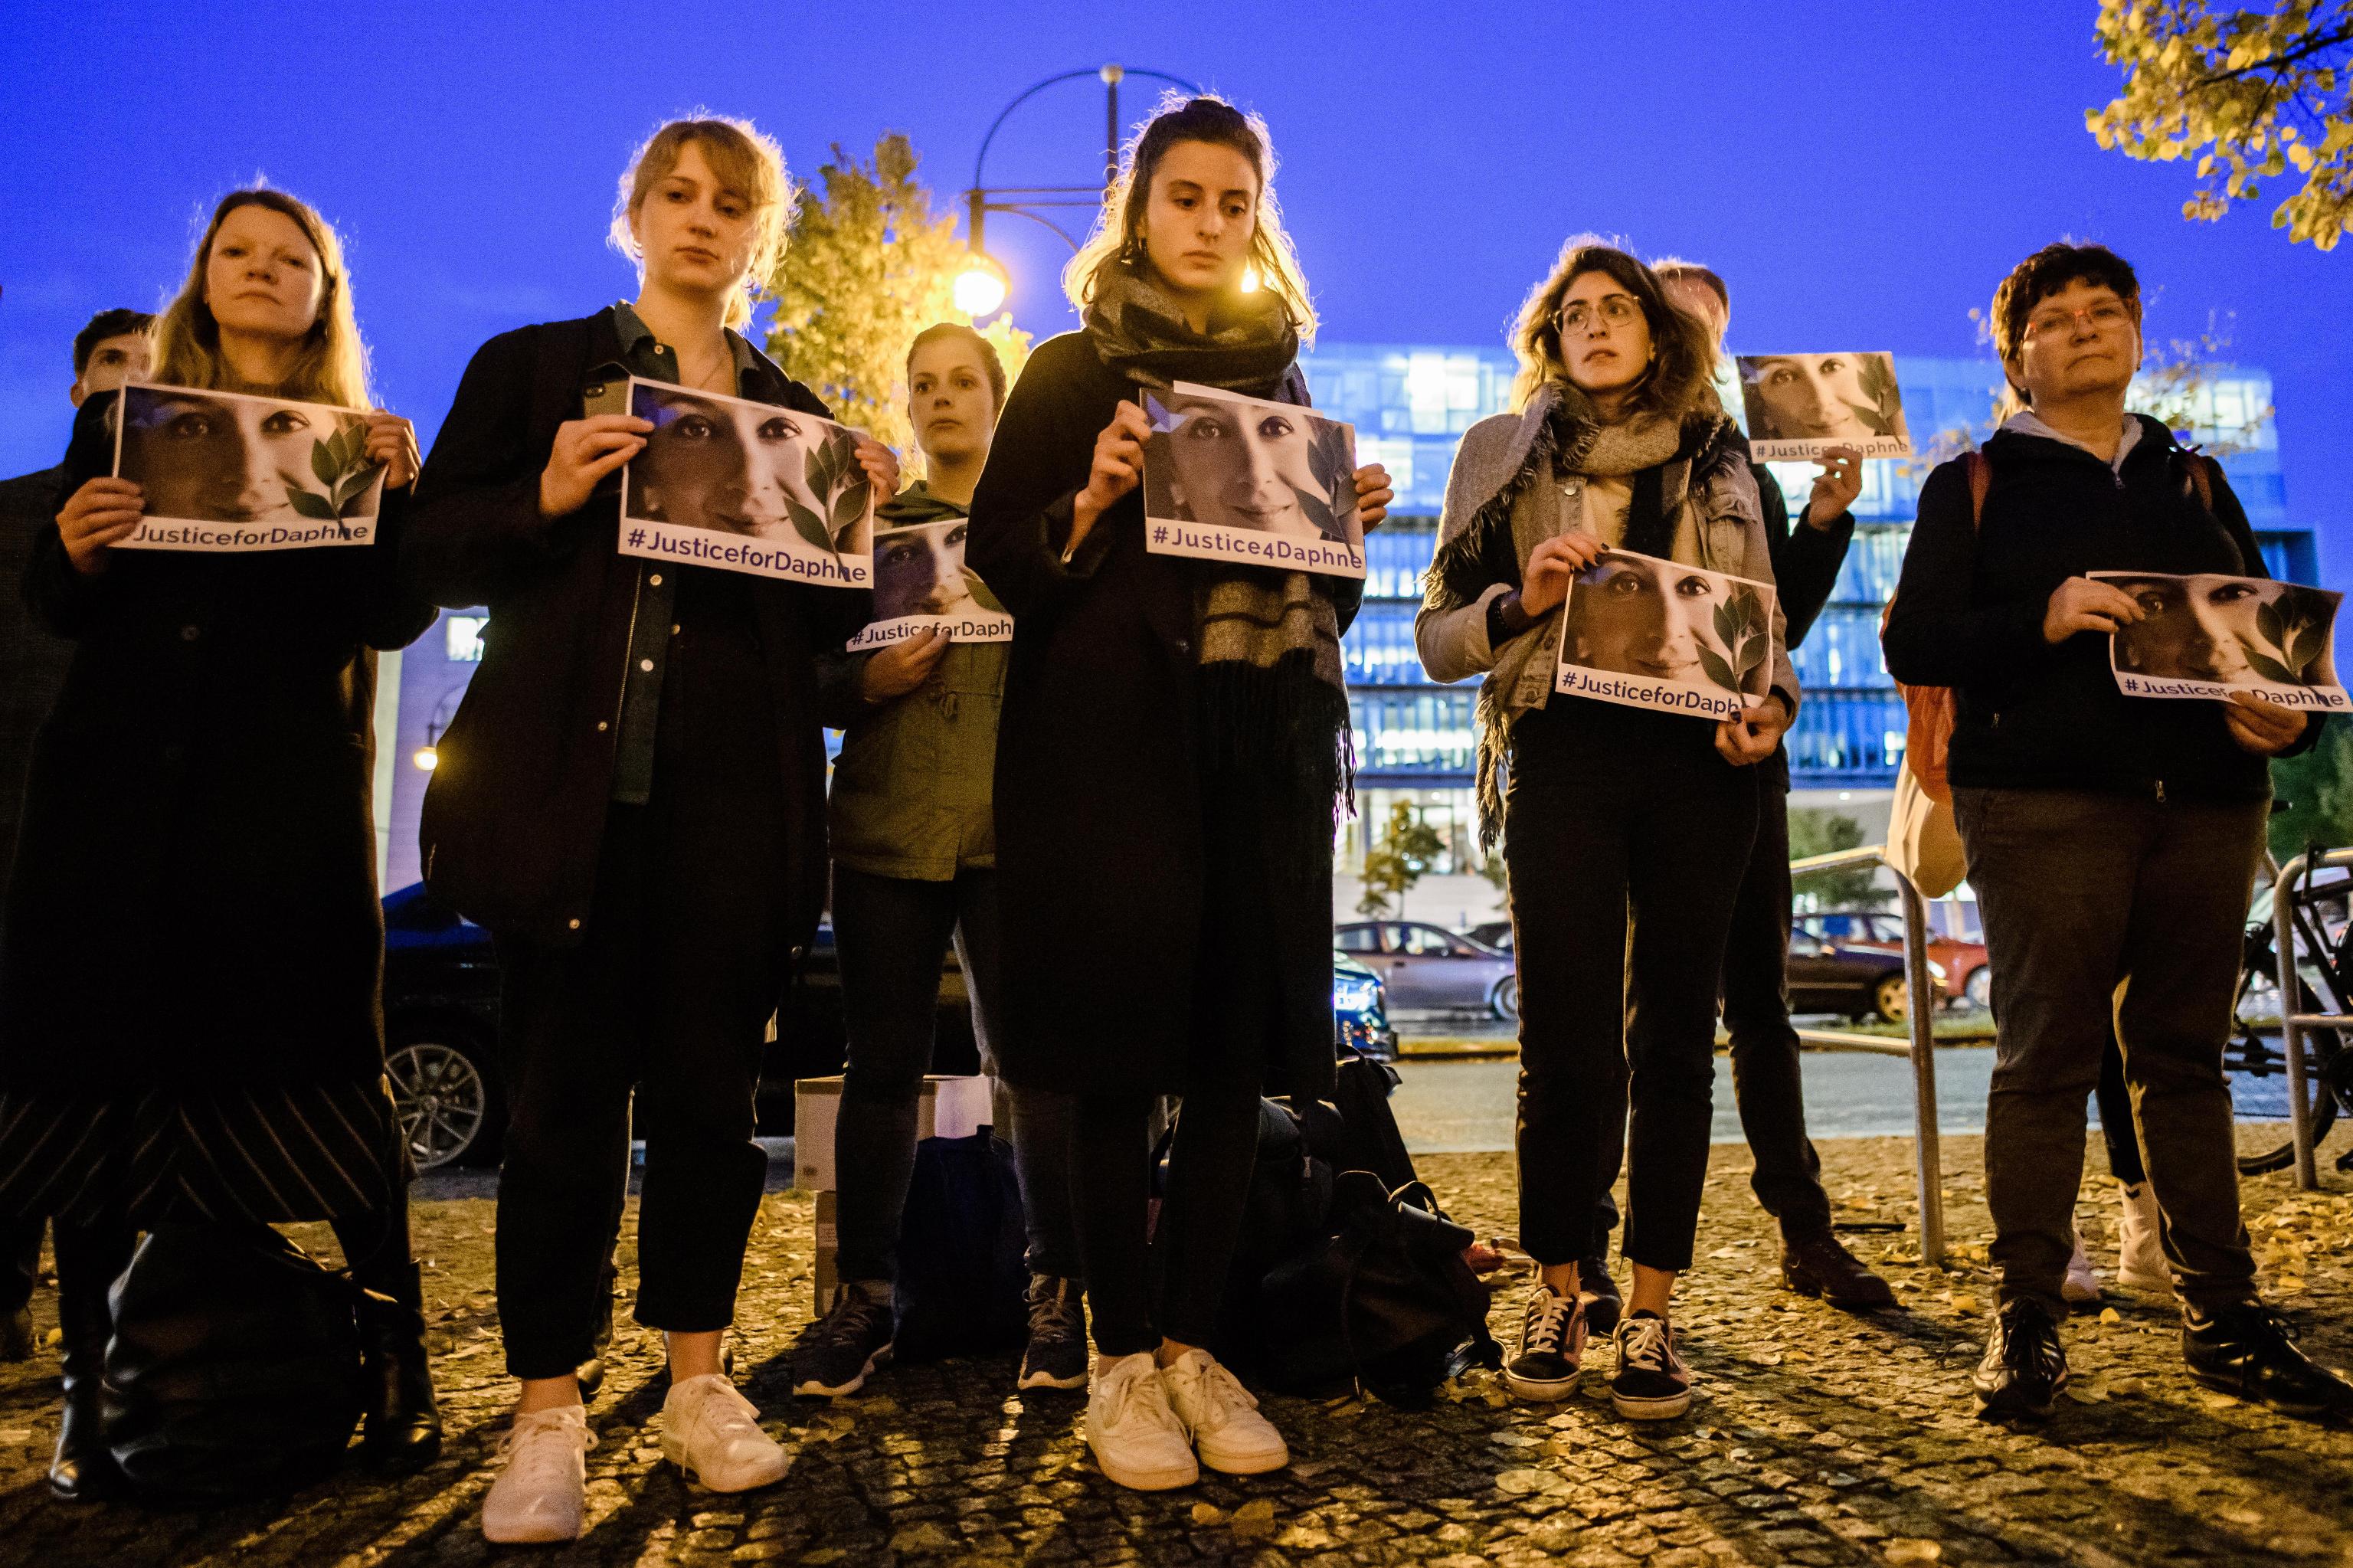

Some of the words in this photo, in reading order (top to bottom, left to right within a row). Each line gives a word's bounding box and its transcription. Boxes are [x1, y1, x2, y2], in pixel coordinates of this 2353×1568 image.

[1756, 442, 1907, 457] #JusticDaphne
[133, 524, 368, 545] JusticeforDaphne
[1154, 526, 1363, 568] #Justice4Daphne
[628, 528, 866, 581] #JusticeforDaphne
[852, 620, 1012, 645] #JusticforDaph
[1562, 672, 1739, 714] #JusticeforDaph
[2125, 679, 2344, 706] #JusticefDaphne
